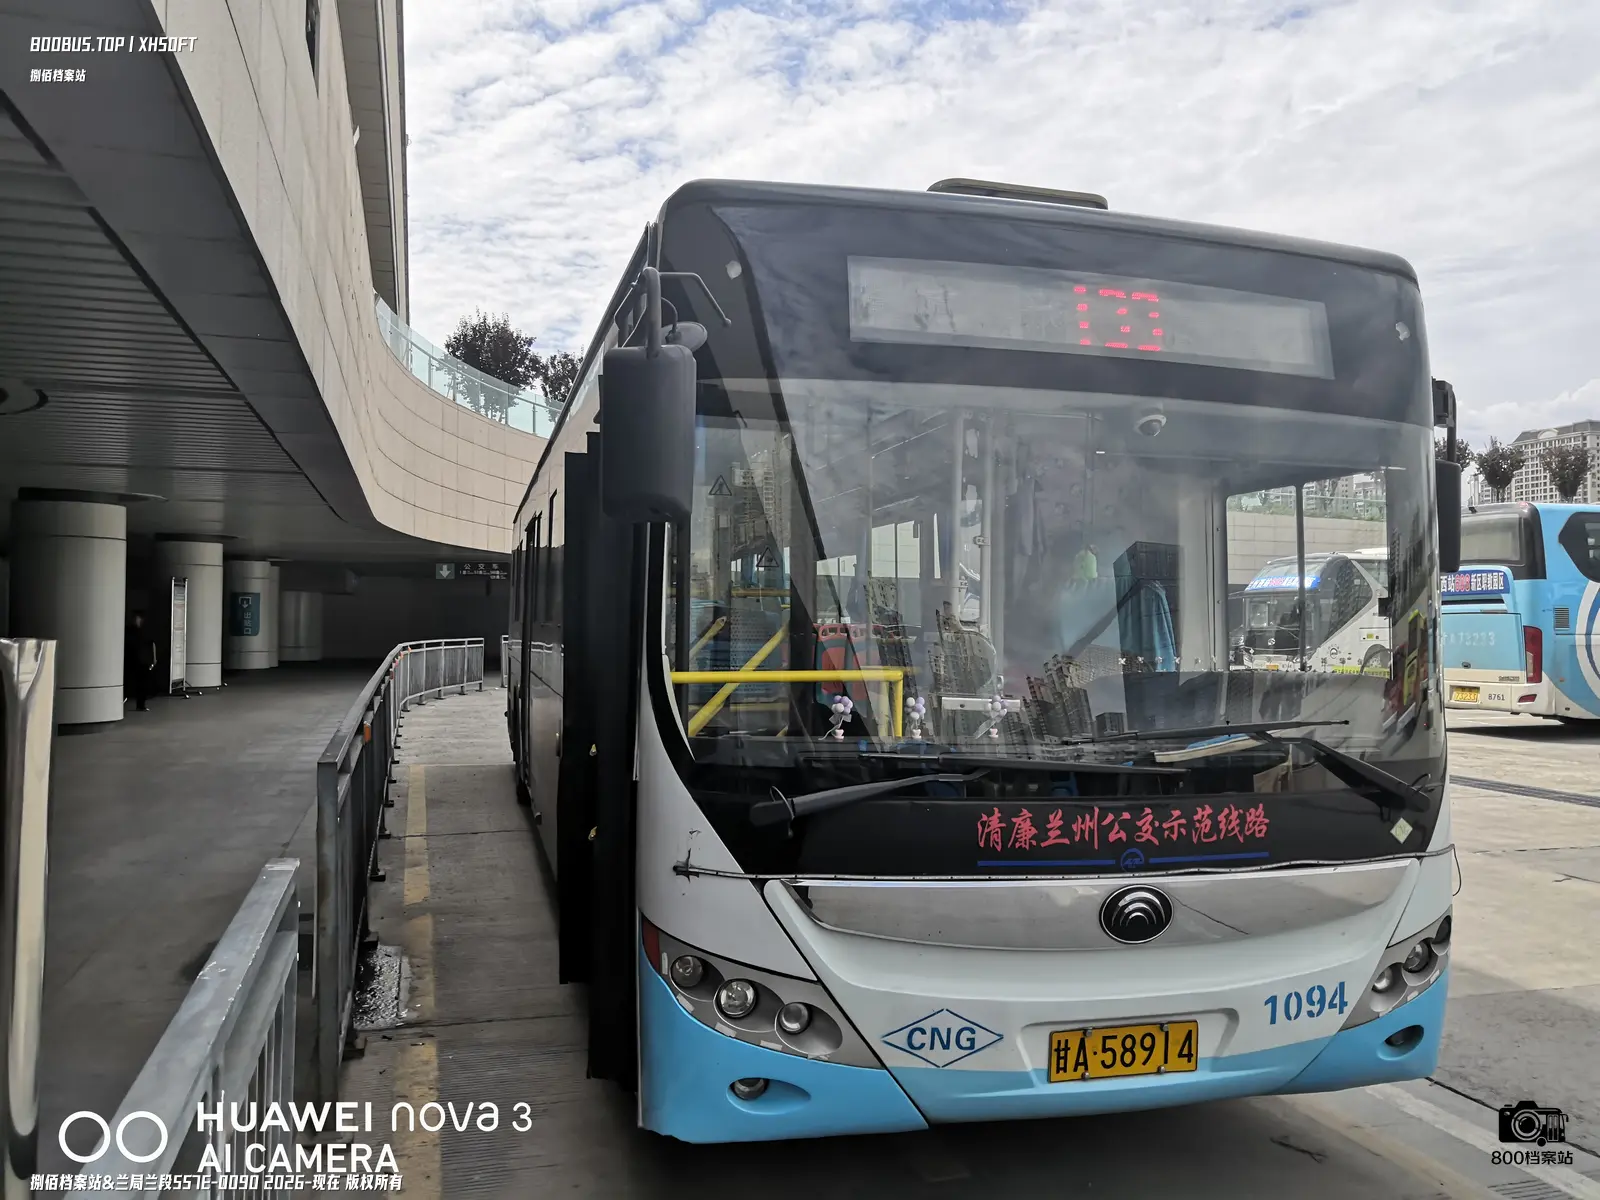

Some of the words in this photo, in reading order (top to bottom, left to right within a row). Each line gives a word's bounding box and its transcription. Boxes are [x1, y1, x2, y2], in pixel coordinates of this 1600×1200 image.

[1487, 693, 1506, 702] 8761
[976, 803, 1271, 853] 清廉兰州公交示范线路
[1263, 980, 1349, 1026] 1094
[906, 1025, 977, 1051] CNG
